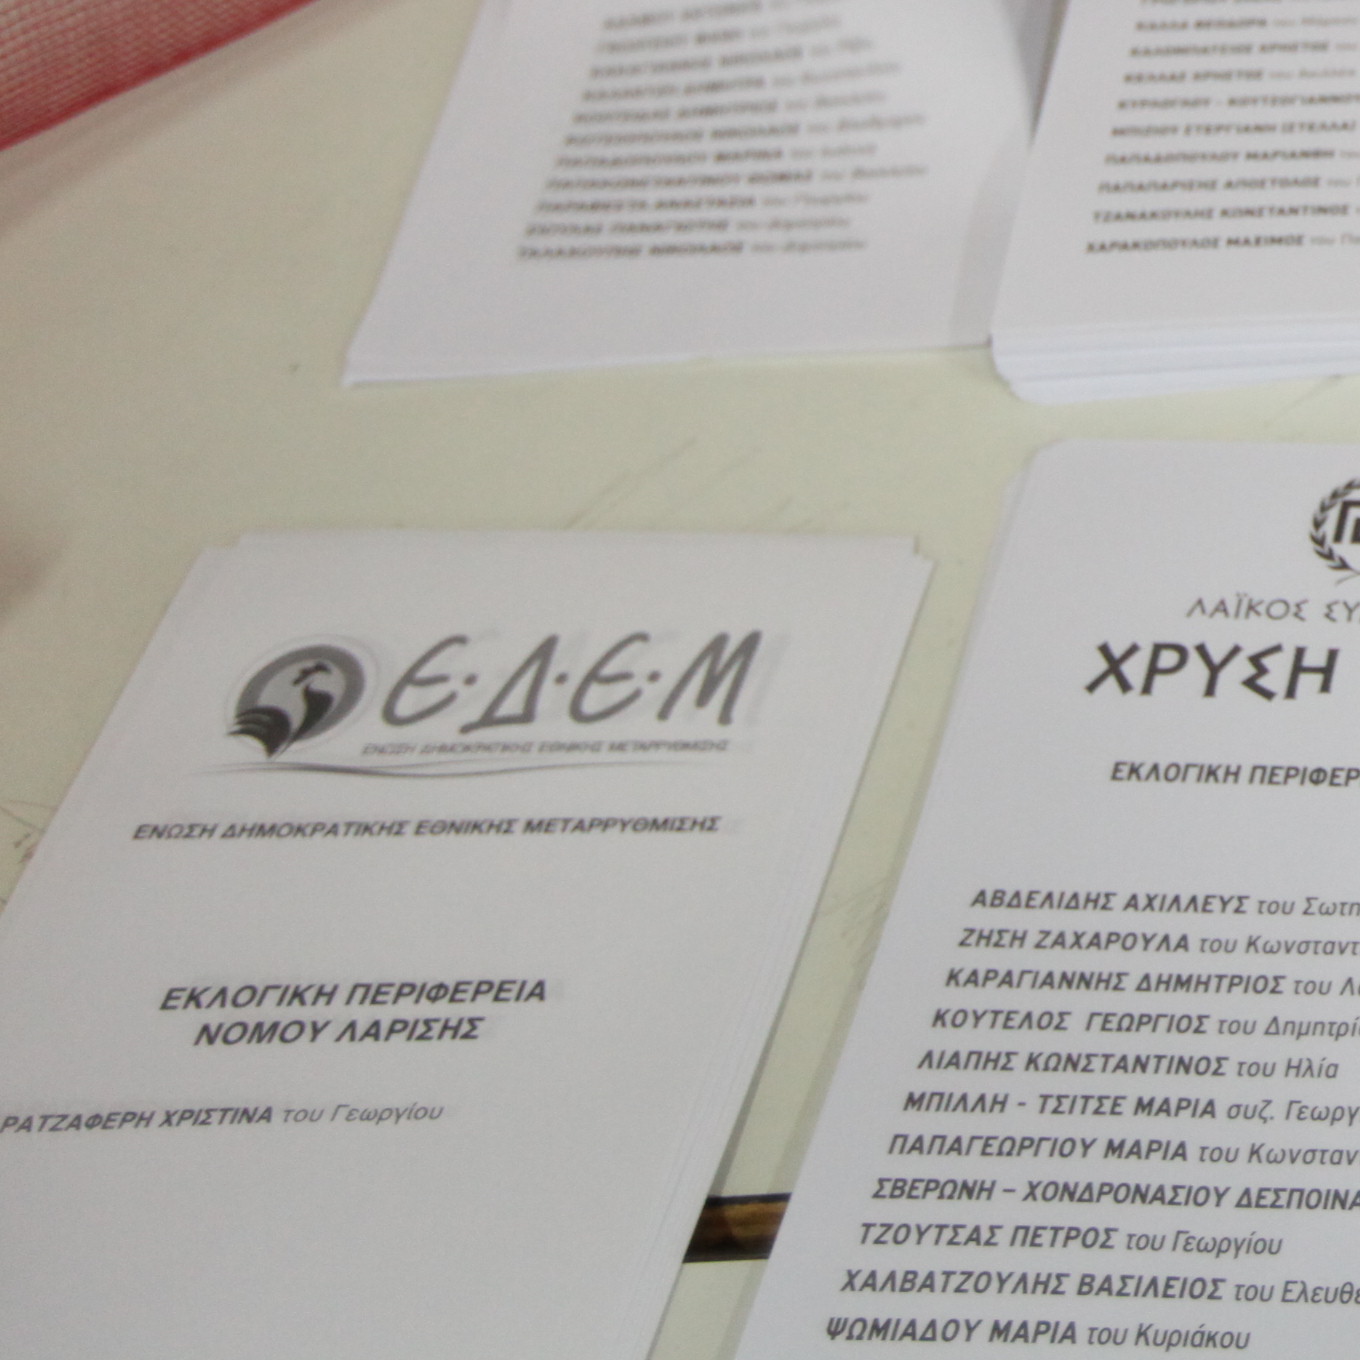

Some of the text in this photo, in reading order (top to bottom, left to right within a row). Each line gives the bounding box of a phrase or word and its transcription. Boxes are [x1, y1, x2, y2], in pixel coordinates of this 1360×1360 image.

[1186, 593, 1308, 622] ΛΑΪΚΟΣ
[1085, 642, 1339, 701] ΧΡΥΣΗ
[1111, 761, 1241, 784] ΕΚΛΟΓΙΚΗ
[133, 816, 721, 840] ΕΝΩΣΗ ΔΗΜΟΚΡΑΤΙΚΗΣ ΕΘΝΙΚΗΣ ΜΕΤΑΡΡΥΘΜΙΣΗΣ
[971, 889, 1117, 911] ΑΒΔΕΛΙΔΗΣ
[1123, 894, 1250, 914] ΑΧΙΛΛΕΥΣ
[1258, 900, 1295, 915] του
[958, 928, 1028, 948] ΖΗΣΗ
[1034, 930, 1189, 952] ΖΑΧΑΡΟΥΛΑ
[1200, 938, 1237, 953] του
[160, 980, 545, 1010] ΕΚΛΟΓΙΚΗ ΠΕΡΙΦΕΡΕΙΑ
[946, 968, 1129, 991] ΚΑΡΑΓΙΑΝΝΗΣ
[1135, 973, 1286, 994] ΔΗΜΗΤΡΙΟΣ
[1294, 980, 1332, 995] του
[194, 1017, 485, 1045] ΝΟΜΟΥ ΛΑΡΙΣΗΣ
[932, 1009, 1071, 1031] ΚΟΥΤΕΛΟΣ
[1085, 1012, 1210, 1034] ΓΕΩΡΓΙΟΣ
[1218, 1020, 1256, 1035] του
[917, 1050, 1339, 1079] ΛΙΑΠΗΣ ΚΩΝΣΤΑΝΤΙΝΟΣ του Ηλία
[0, 1102, 444, 1133] ΡΑΤΖΑΦΕΡΗ ΧΡΙΣΤΙΝΑ του Γεωργίου
[888, 1134, 1097, 1158] ΠΑΠΑΓΕΩΡΓΙΟΥ
[1104, 1139, 1187, 1161] ΜΑΡΙΑ
[1199, 1146, 1239, 1163] του
[861, 1223, 1282, 1259] ΤΖΟΥΤΣΑΣ ΠΕΤΡΟΣ του Γεωργίου
[840, 1270, 1070, 1295] ΧΑΛΒΑΤΖΟΥΛΗΣ
[1077, 1274, 1226, 1300] ΒΑΣΙΛΕΙΟΣ
[1235, 1284, 1274, 1302] του
